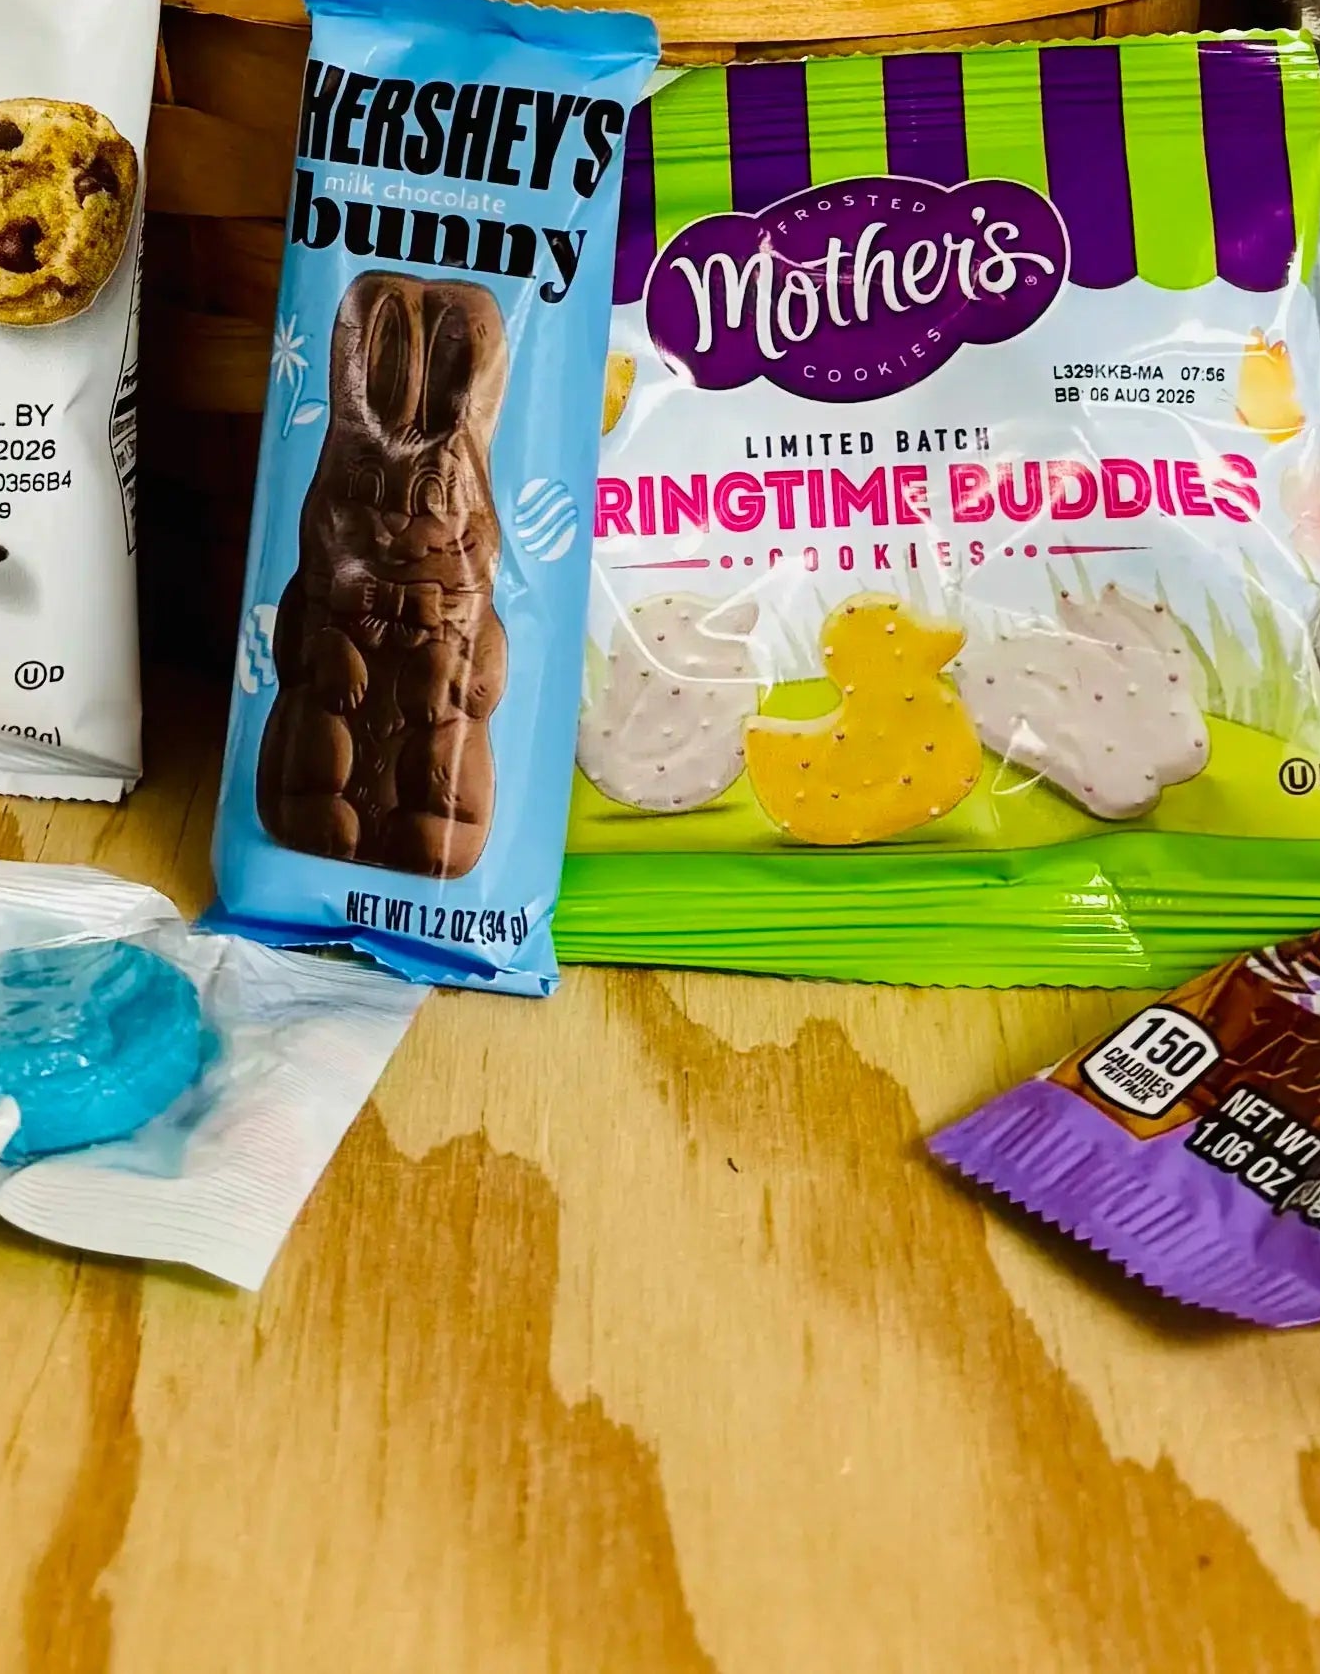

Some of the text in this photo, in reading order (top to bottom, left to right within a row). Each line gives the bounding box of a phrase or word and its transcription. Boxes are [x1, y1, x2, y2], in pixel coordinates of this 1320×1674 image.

[297, 58, 625, 200] HERSHEY'S
[324, 170, 507, 215] milk chocolate
[776, 193, 927, 235] FROSTED
[290, 167, 588, 304] bunny
[668, 206, 1056, 360] Mother's
[802, 327, 943, 383] COOKIES
[1180, 366, 1226, 382] 07:56
[16, 403, 54, 427] BY
[1090, 387, 1109, 403] 06
[1114, 387, 1151, 403] AUG
[1156, 388, 1196, 404] 2026
[745, 427, 992, 459] LIMITED BATCH
[950, 452, 1261, 524] BUDDIES
[346, 890, 382, 928] NET
[385, 898, 414, 933] WT
[419, 903, 446, 940] 1.2
[450, 908, 477, 944] OZ
[1103, 1046, 1175, 1100] CALORIES
[1129, 1016, 1207, 1077] 150
[1098, 1062, 1156, 1105] PER PACK
[1219, 1088, 1285, 1133] NET
[1192, 1121, 1255, 1167] 1.06
[1245, 1156, 1297, 1197] OZ
